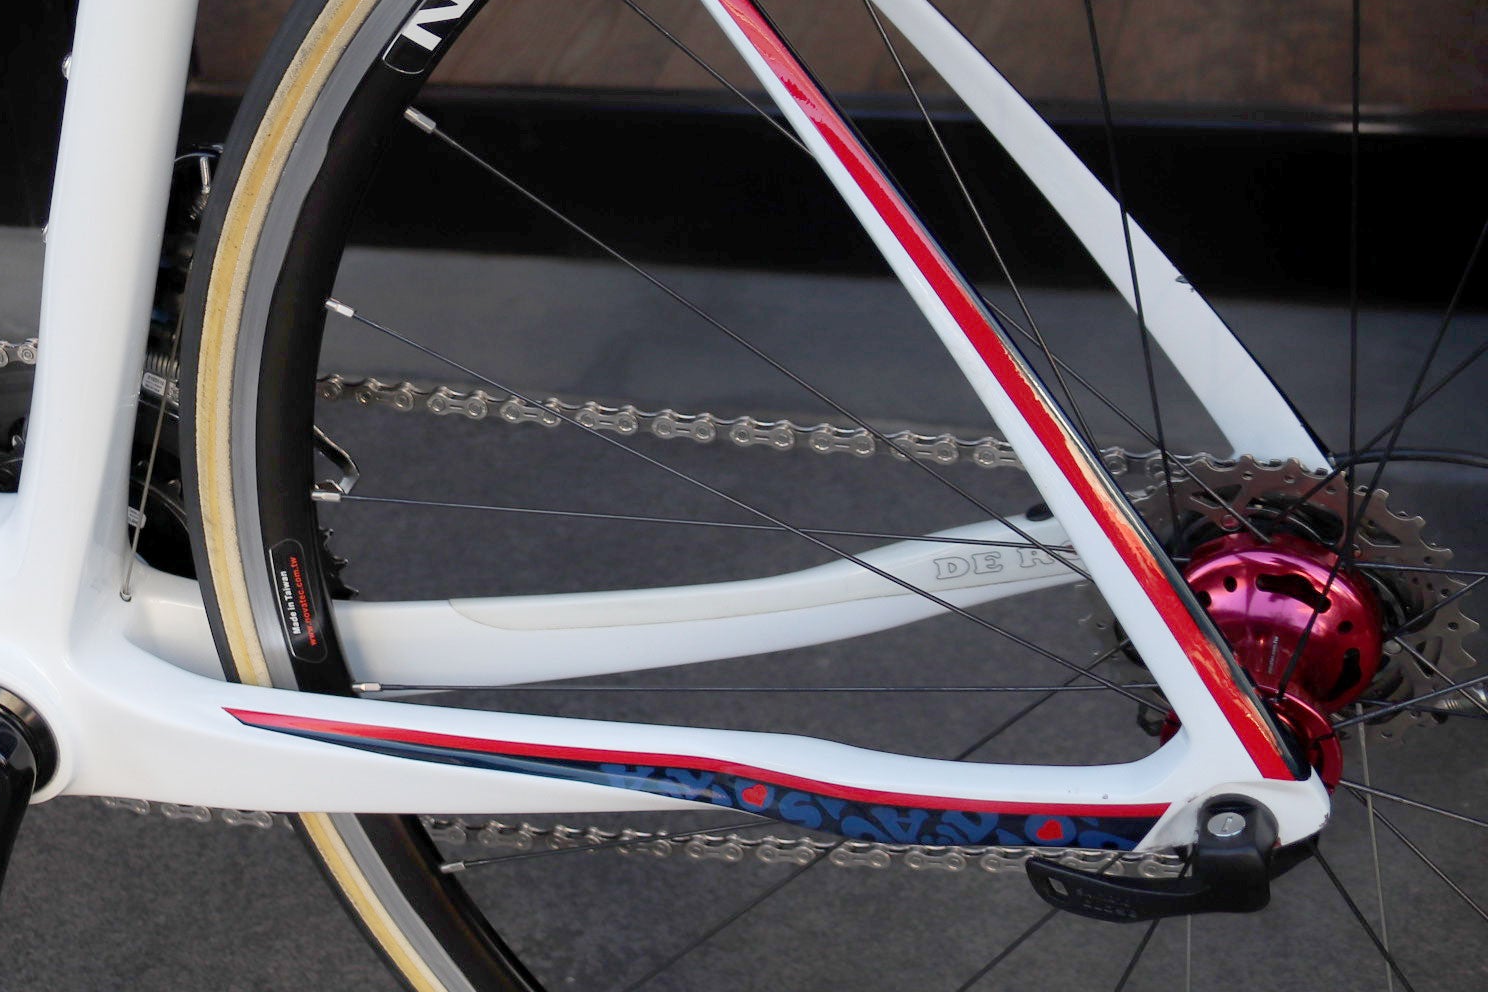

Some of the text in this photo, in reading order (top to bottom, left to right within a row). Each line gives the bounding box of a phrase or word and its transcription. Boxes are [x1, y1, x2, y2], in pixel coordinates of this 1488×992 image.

[933, 551, 1004, 580] DE
[280, 570, 302, 635] Made in Taiwan
[289, 556, 318, 646] www.novatec.com.tw
